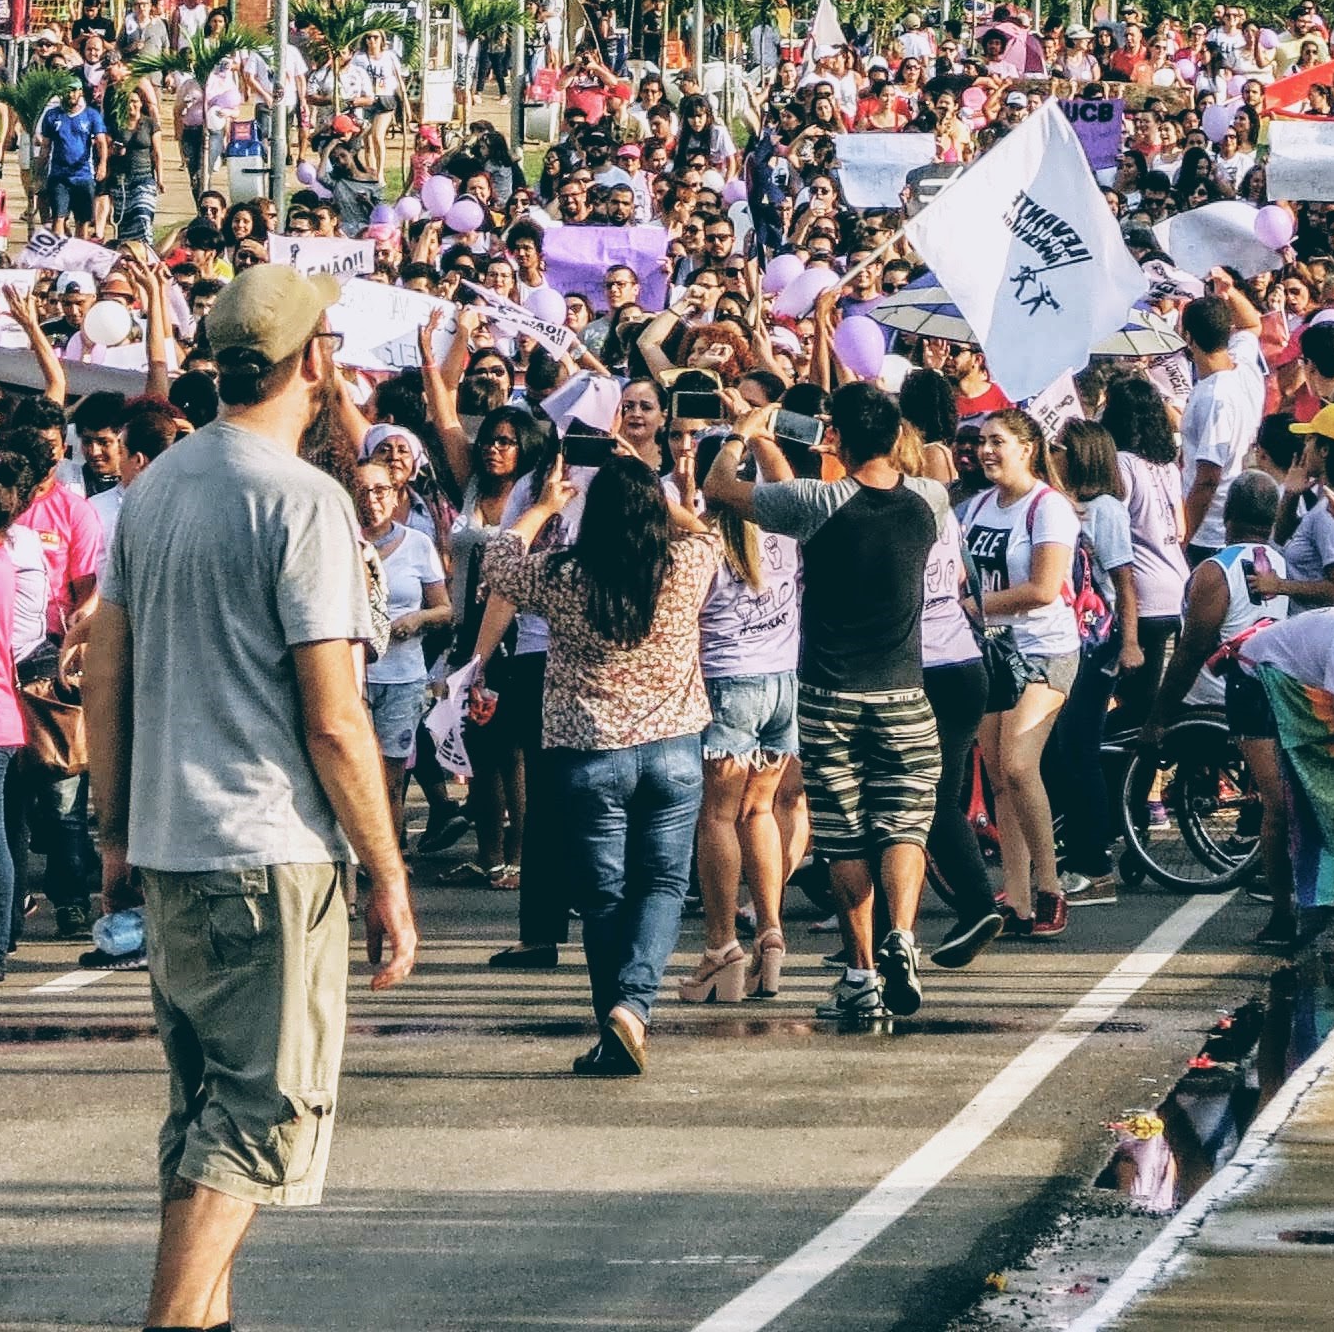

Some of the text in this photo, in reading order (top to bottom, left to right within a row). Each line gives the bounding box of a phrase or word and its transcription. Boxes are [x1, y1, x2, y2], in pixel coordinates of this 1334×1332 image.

[1062, 101, 1114, 123] UCB
[1037, 404, 1061, 432] #EL
[971, 530, 1005, 558] ELE
[980, 563, 1002, 592] ÃO
